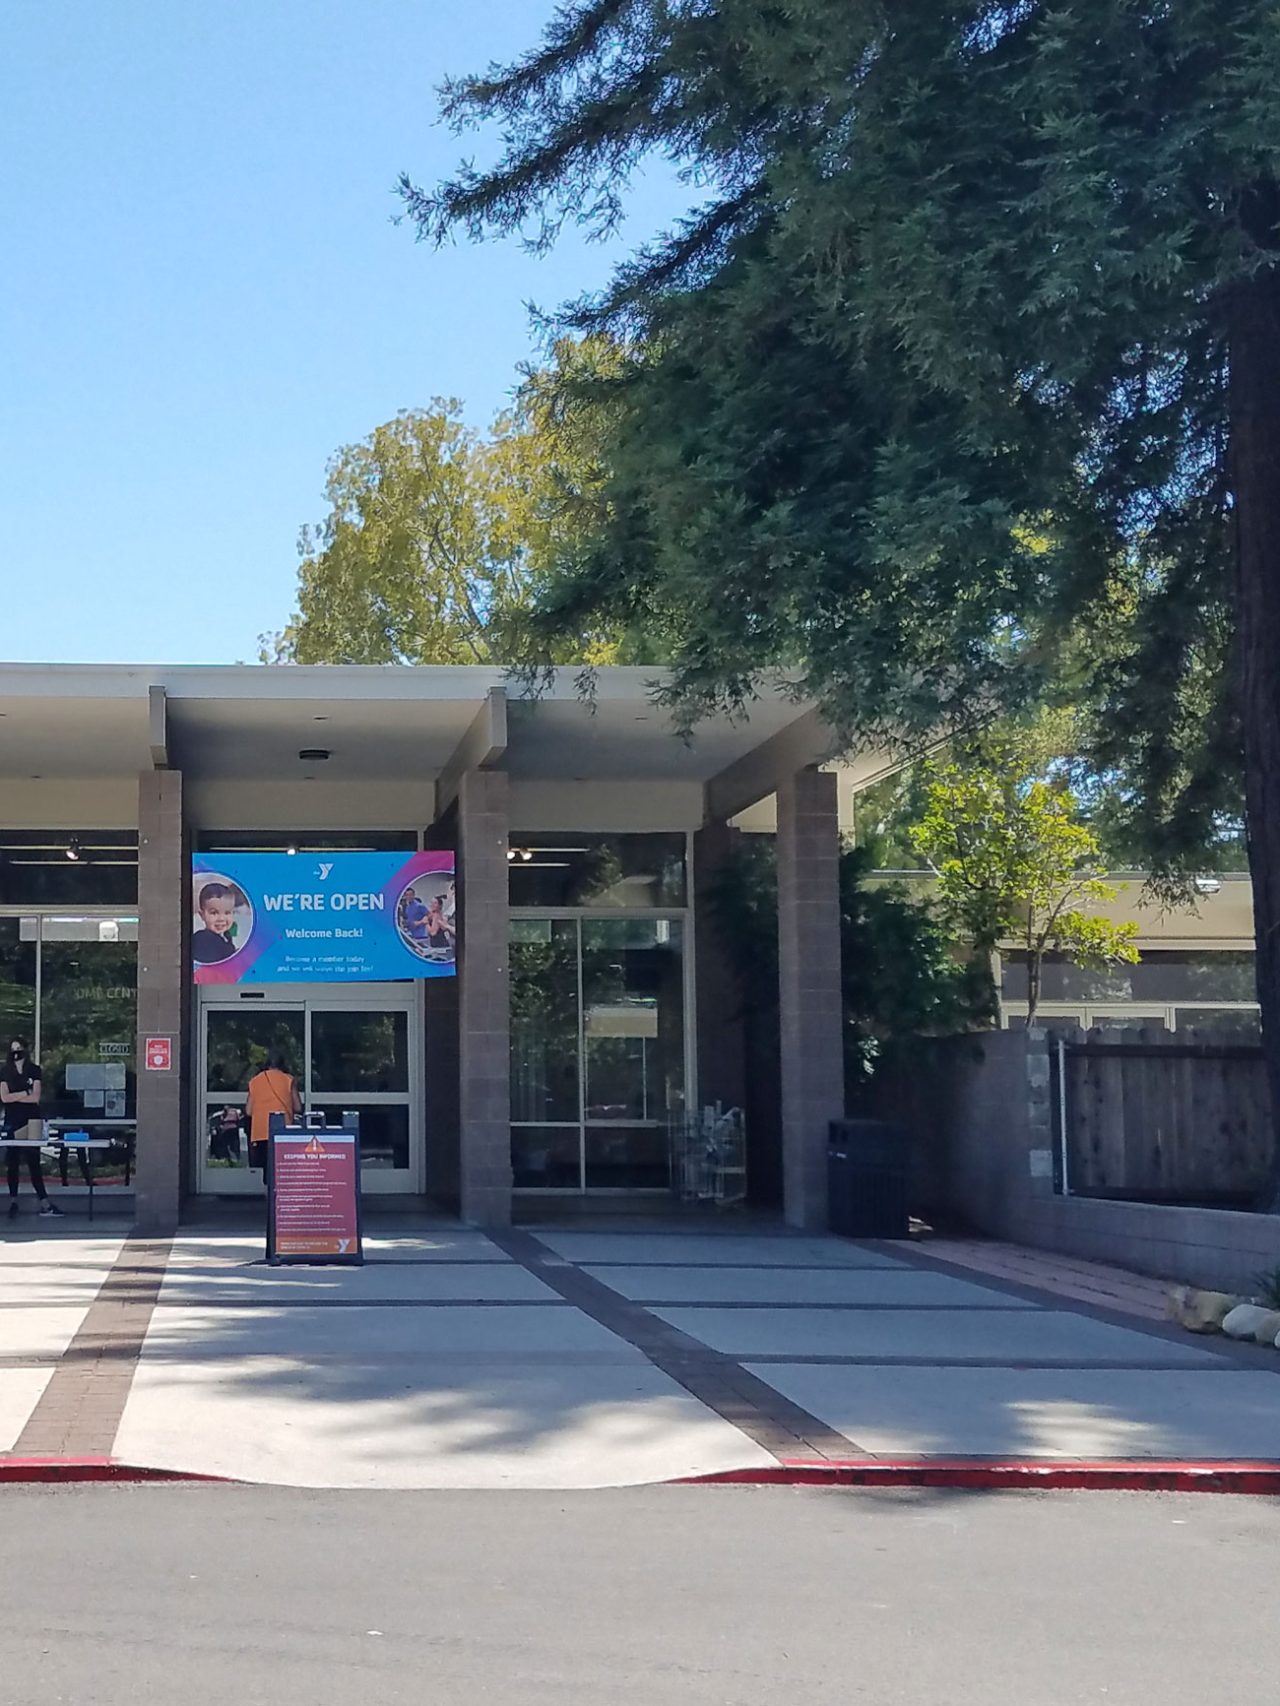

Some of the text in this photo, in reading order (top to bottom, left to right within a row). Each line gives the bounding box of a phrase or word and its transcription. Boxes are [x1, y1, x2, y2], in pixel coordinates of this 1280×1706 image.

[330, 893, 384, 911] OPEN
[285, 928, 363, 938] Welcome Back!
